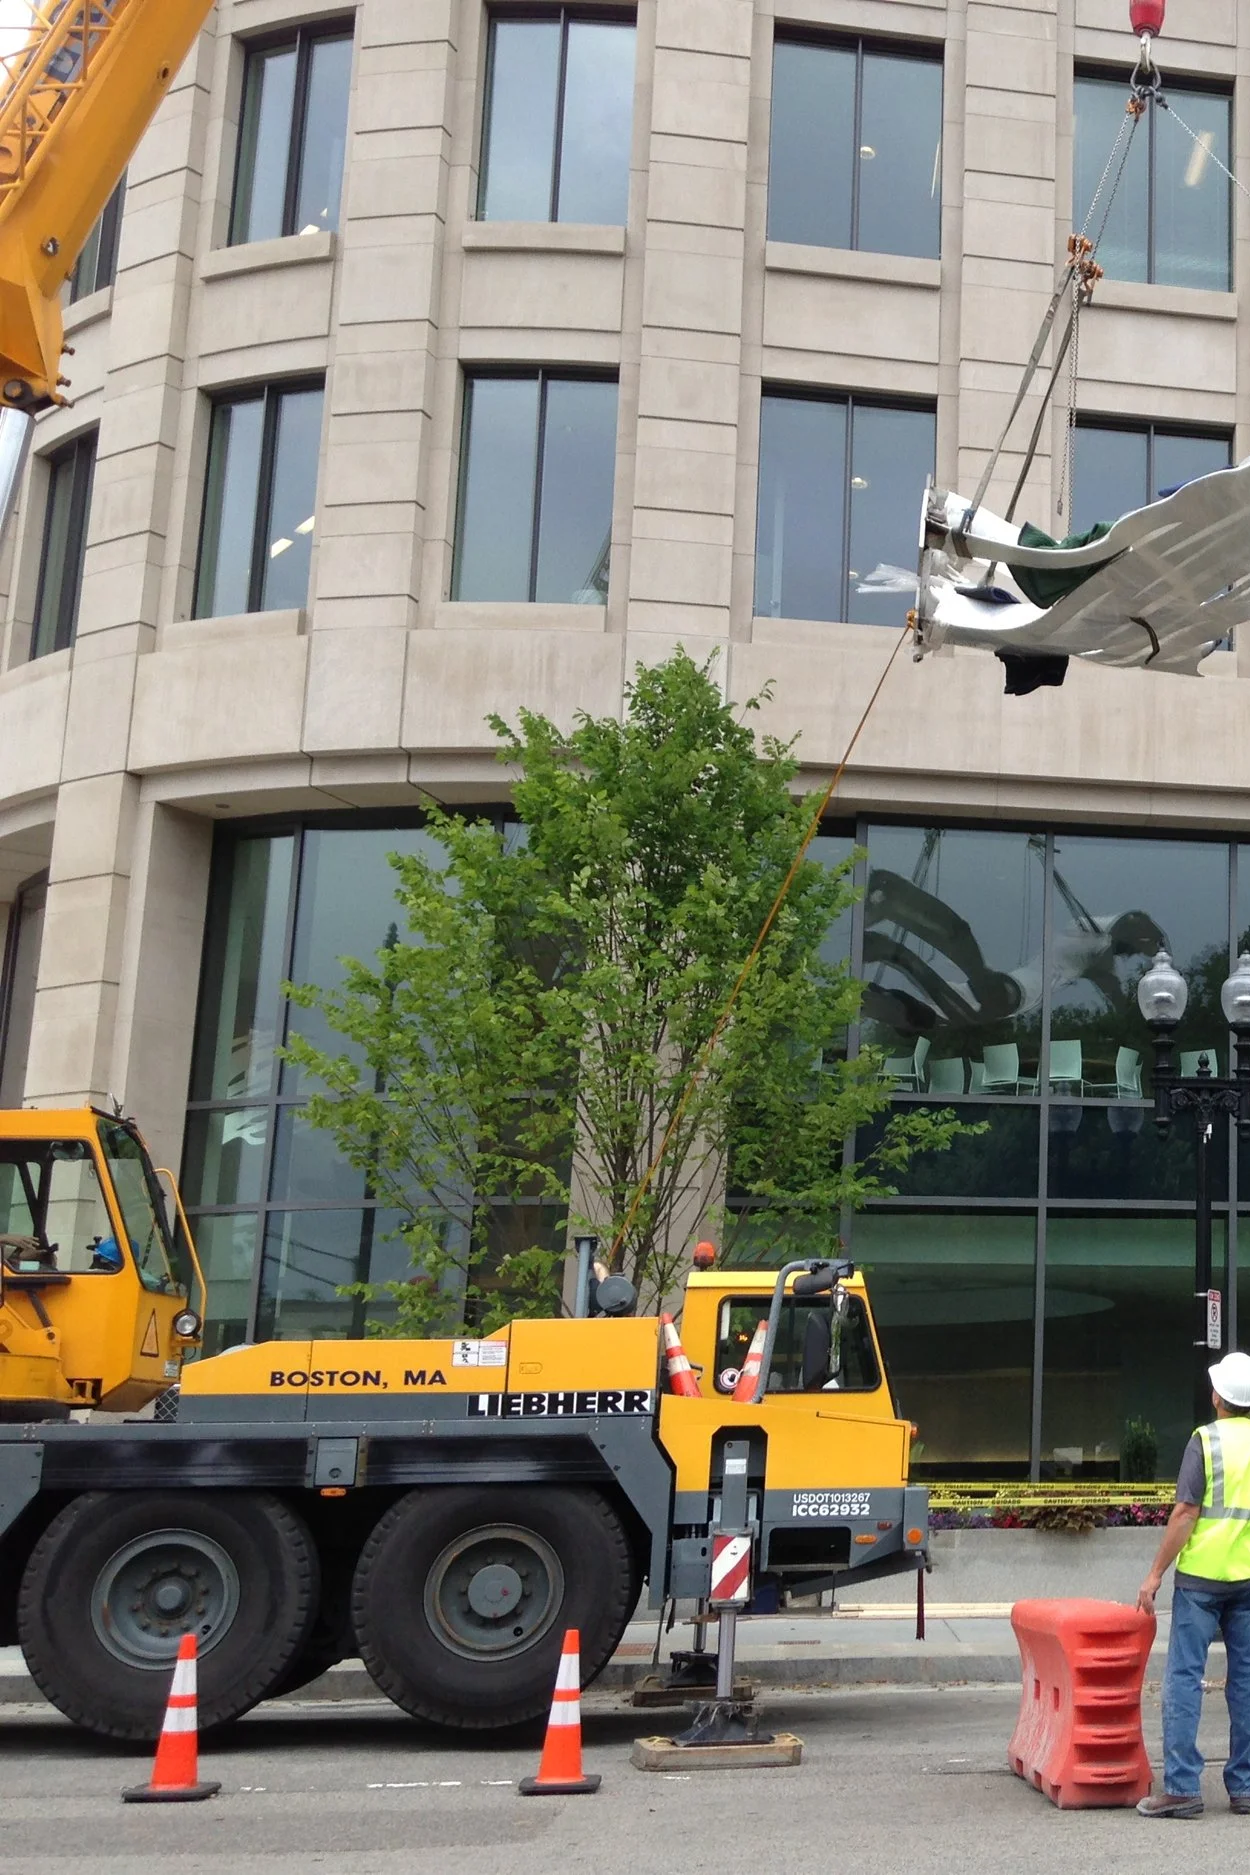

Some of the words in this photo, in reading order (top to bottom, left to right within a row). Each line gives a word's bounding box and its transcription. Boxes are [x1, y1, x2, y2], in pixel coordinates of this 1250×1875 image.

[270, 1369, 388, 1389] BOSTON,
[404, 1370, 447, 1386] MA
[468, 1391, 650, 1416] LIEBHERR
[793, 1492, 871, 1504] USDOT1013267
[792, 1503, 871, 1517] ICC62932
